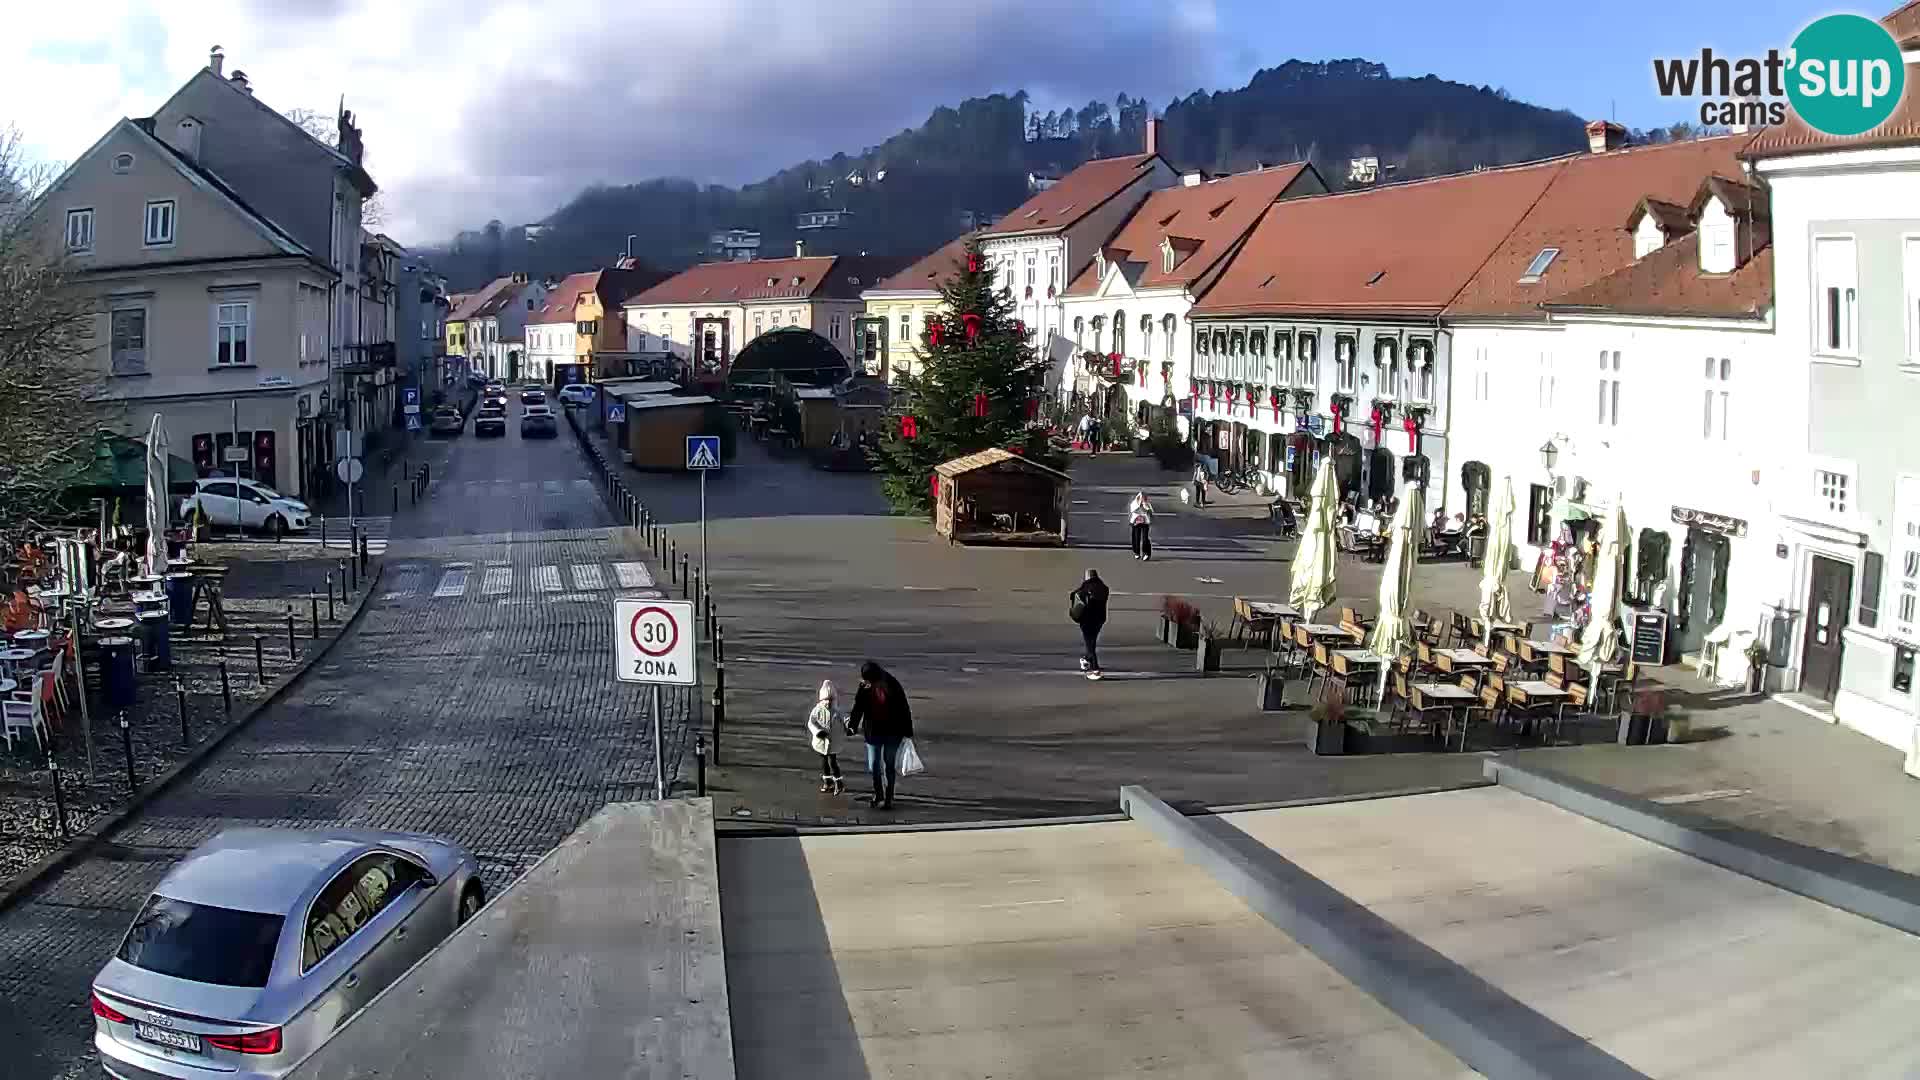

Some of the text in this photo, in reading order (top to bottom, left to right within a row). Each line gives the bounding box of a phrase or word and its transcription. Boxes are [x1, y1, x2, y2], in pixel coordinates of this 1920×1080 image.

[407, 392, 416, 403] P
[643, 623, 667, 643] 30
[634, 660, 677, 676] ZONA
